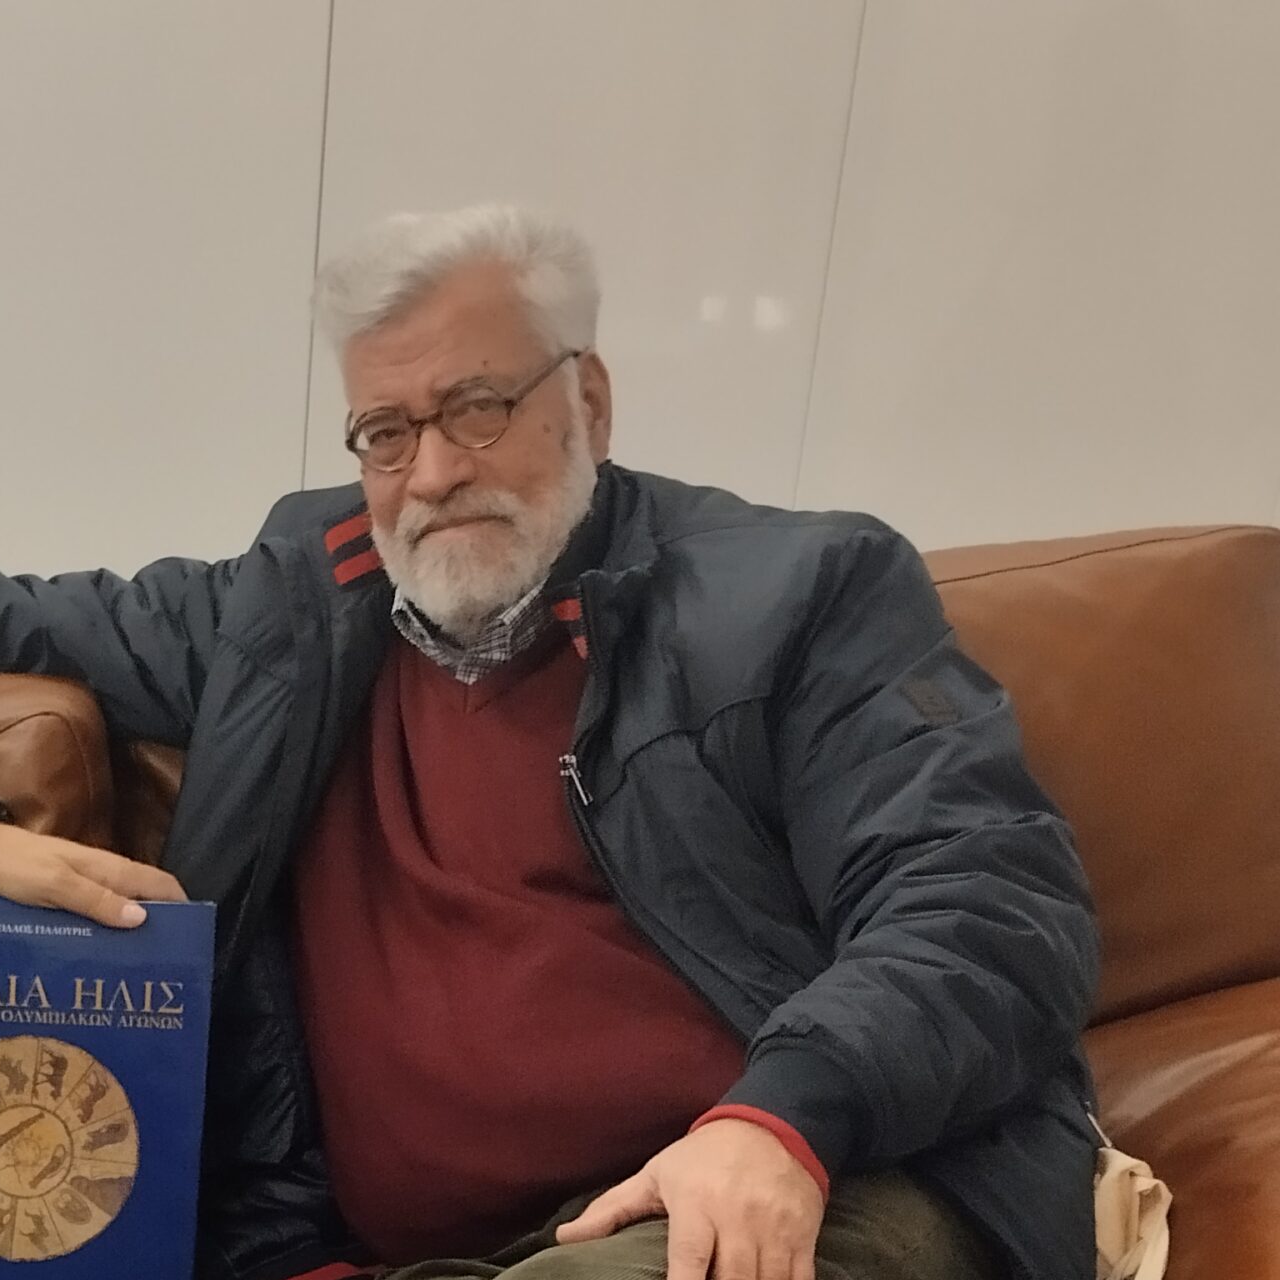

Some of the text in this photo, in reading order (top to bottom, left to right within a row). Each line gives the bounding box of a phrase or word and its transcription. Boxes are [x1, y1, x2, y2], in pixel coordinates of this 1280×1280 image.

[72, 977, 184, 1014] ΗΛΙΣ
[1, 1009, 112, 1026] ΟΛΥΜΠΙΑΚΩΝ
[118, 1014, 183, 1029] ΑΓΩΝΩΝ
